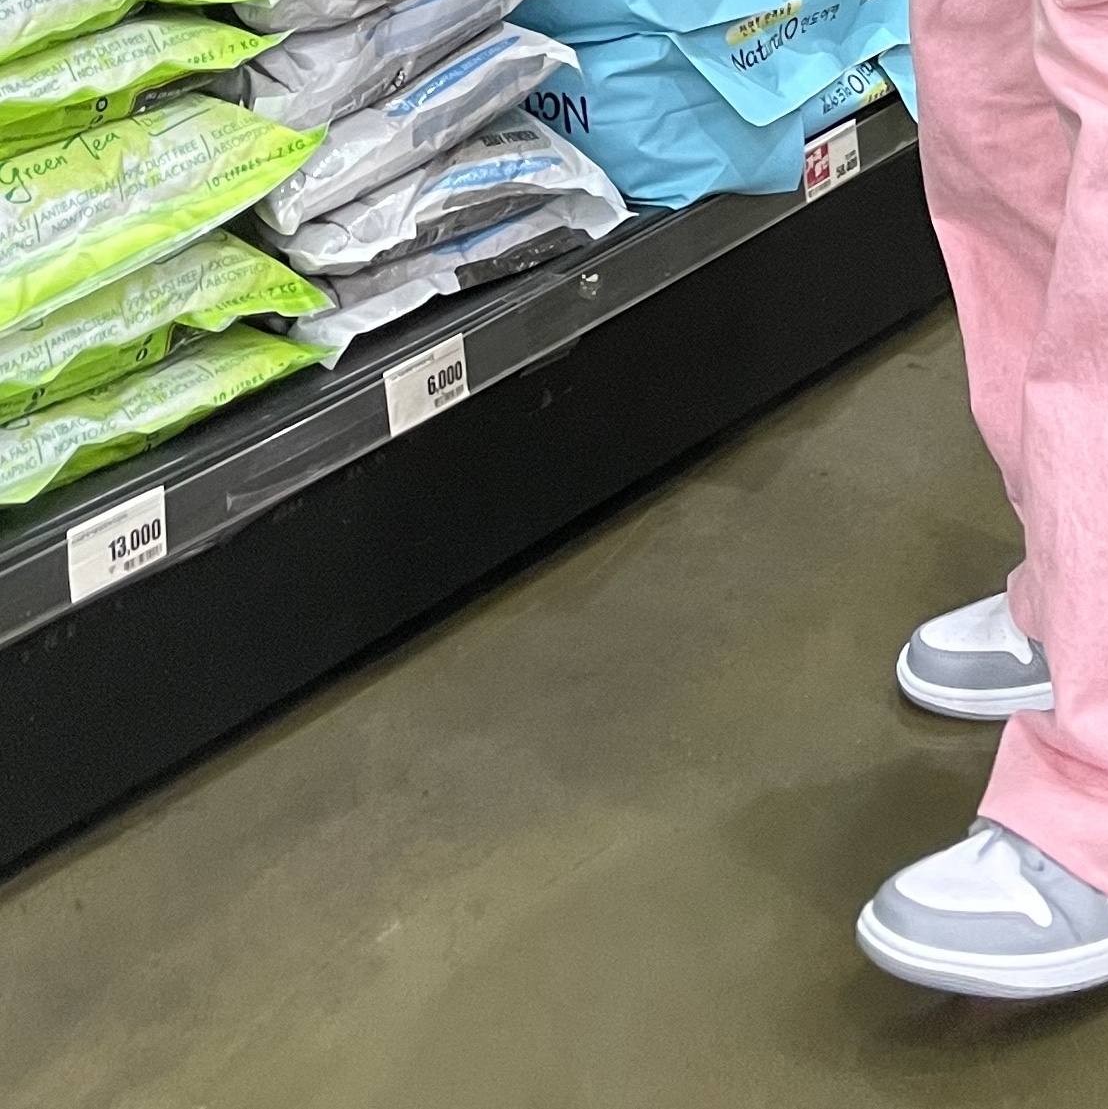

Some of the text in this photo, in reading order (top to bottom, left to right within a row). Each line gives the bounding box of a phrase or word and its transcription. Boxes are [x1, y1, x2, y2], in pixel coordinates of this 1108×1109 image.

[172, 139, 201, 158] FREE
[288, 138, 306, 153] KG
[149, 152, 208, 188] TRACKING
[280, 281, 298, 294] KG
[426, 360, 463, 397] 6,000
[107, 518, 162, 562] 13,000
